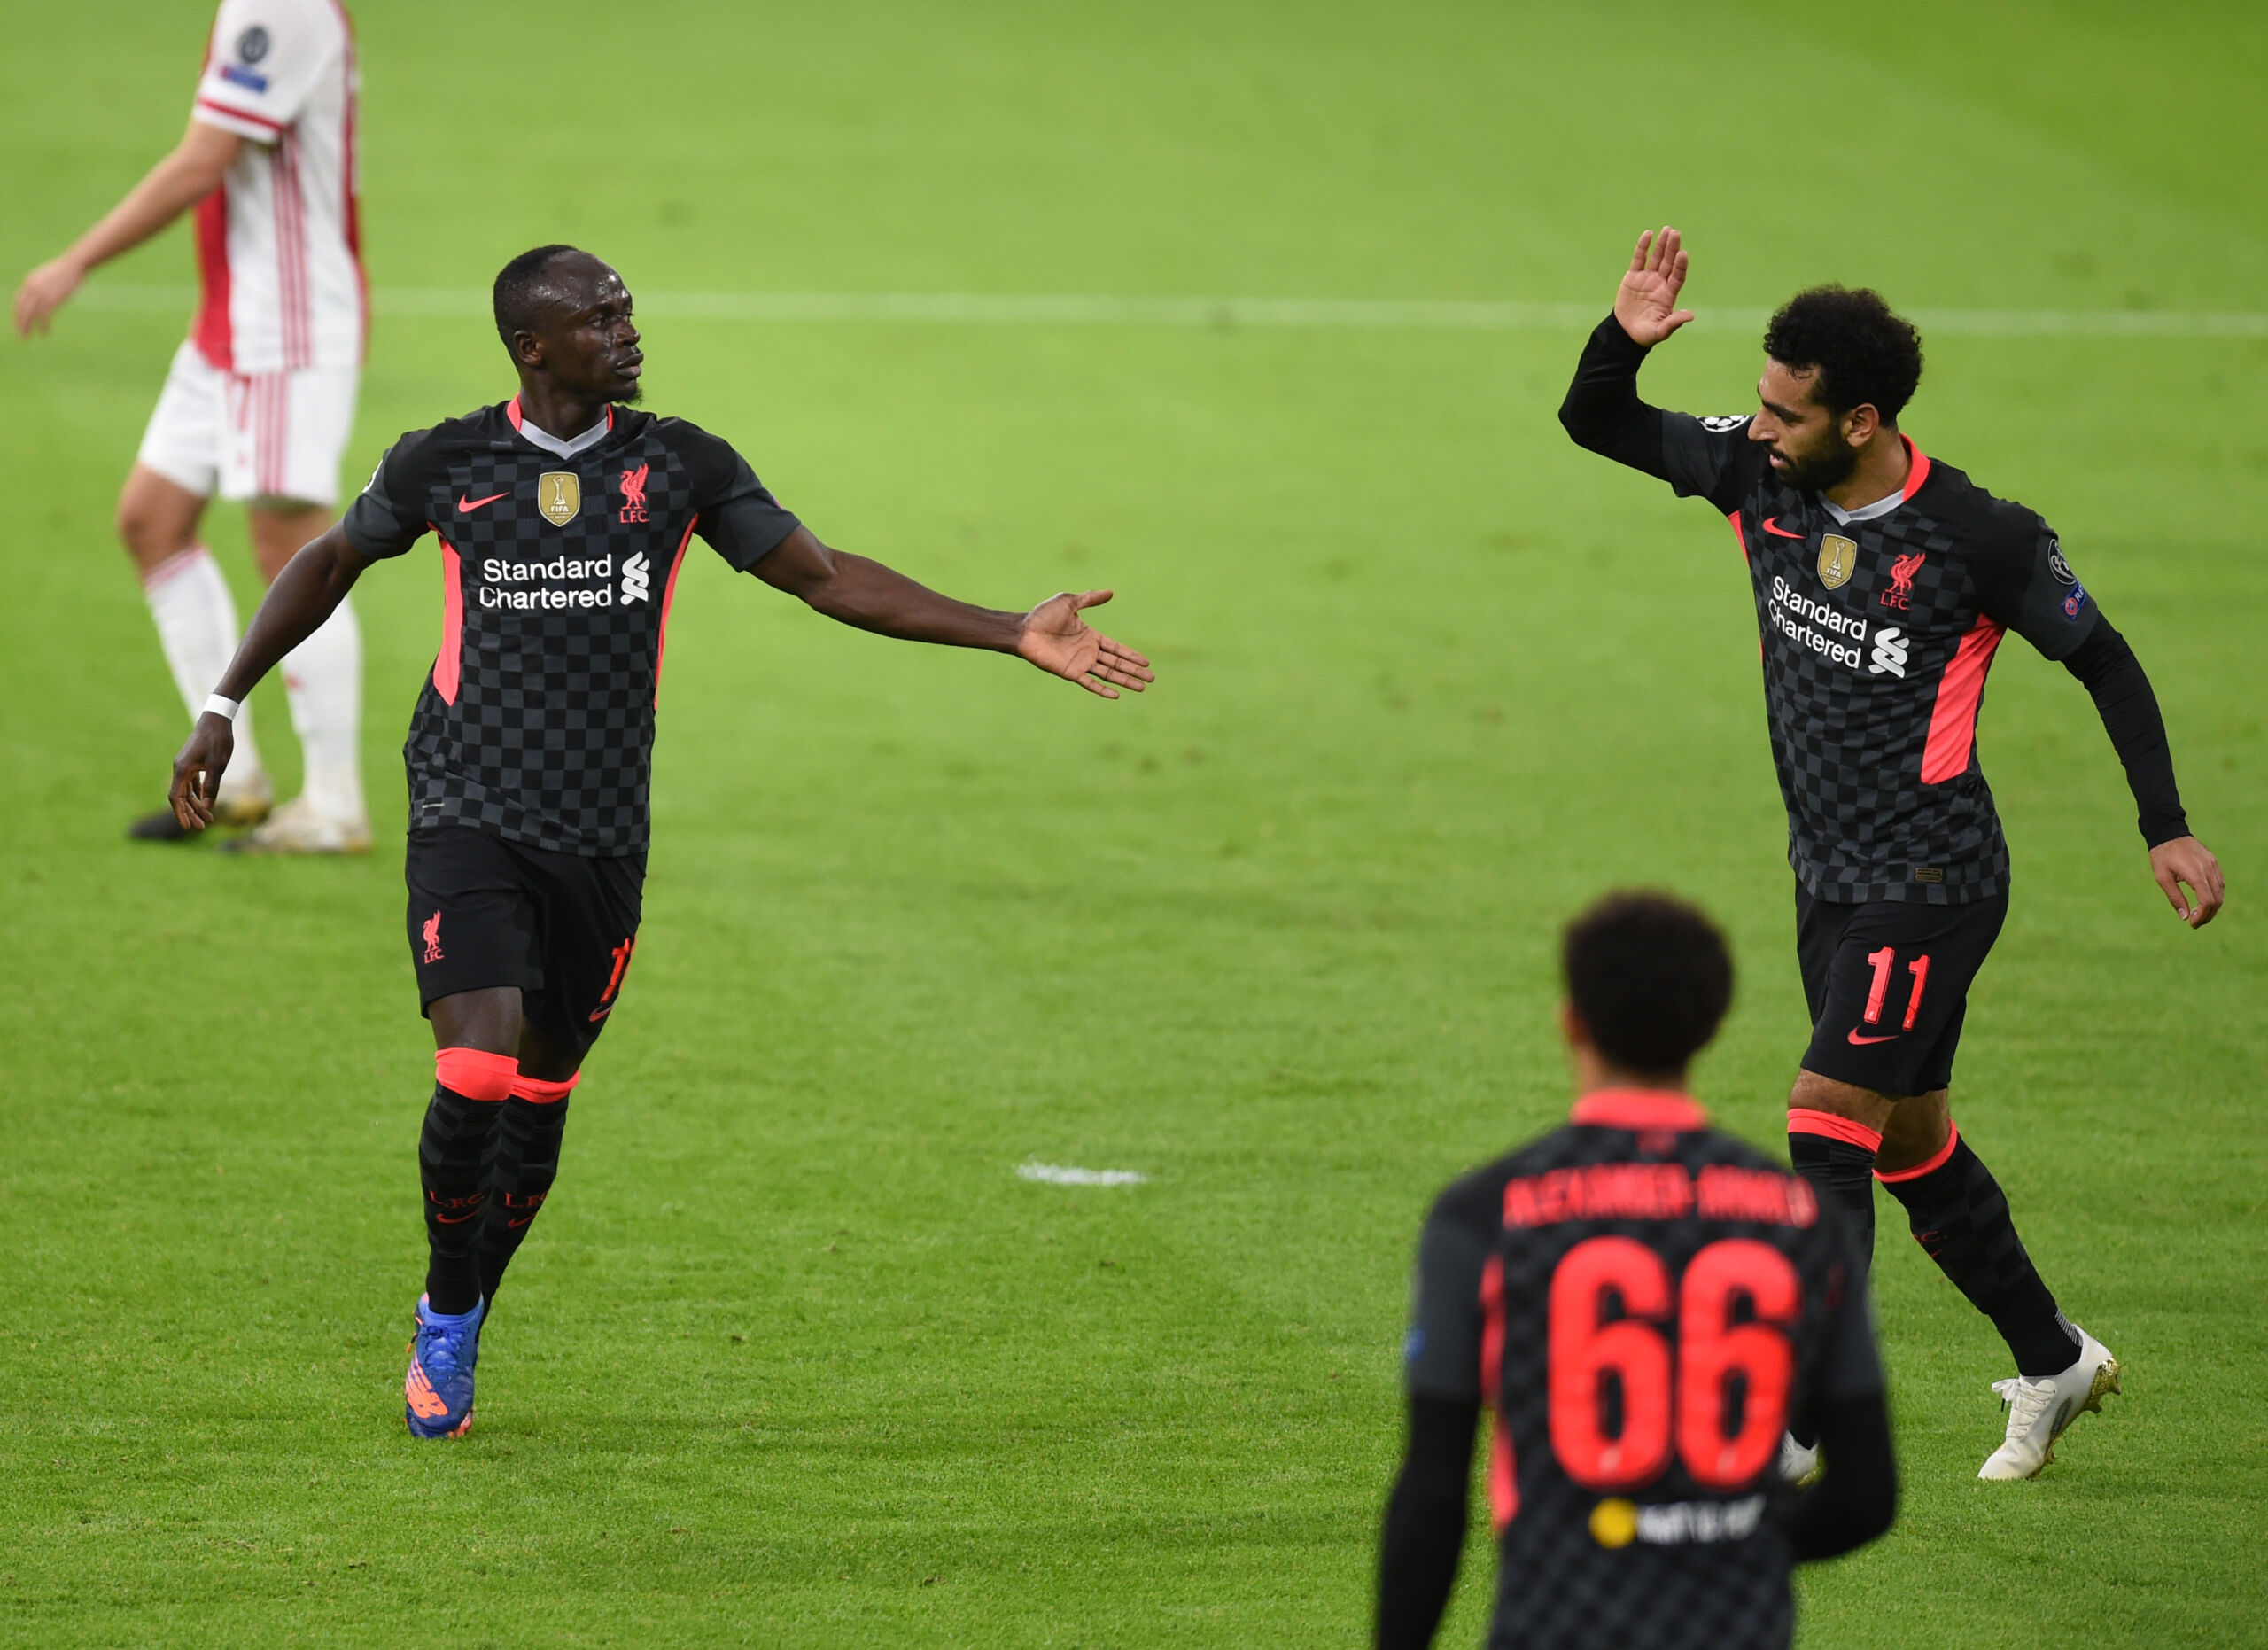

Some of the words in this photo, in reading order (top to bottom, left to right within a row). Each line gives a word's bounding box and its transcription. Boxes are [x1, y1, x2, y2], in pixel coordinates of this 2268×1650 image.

[479, 583, 612, 610] Chartered
[483, 553, 612, 582] Standard
[1826, 567, 1841, 578] FIFA
[1768, 598, 1861, 669] Chartered
[1773, 575, 1868, 641] Standard
[1863, 946, 1930, 1031] 11
[1546, 1234, 1804, 1492] 66
